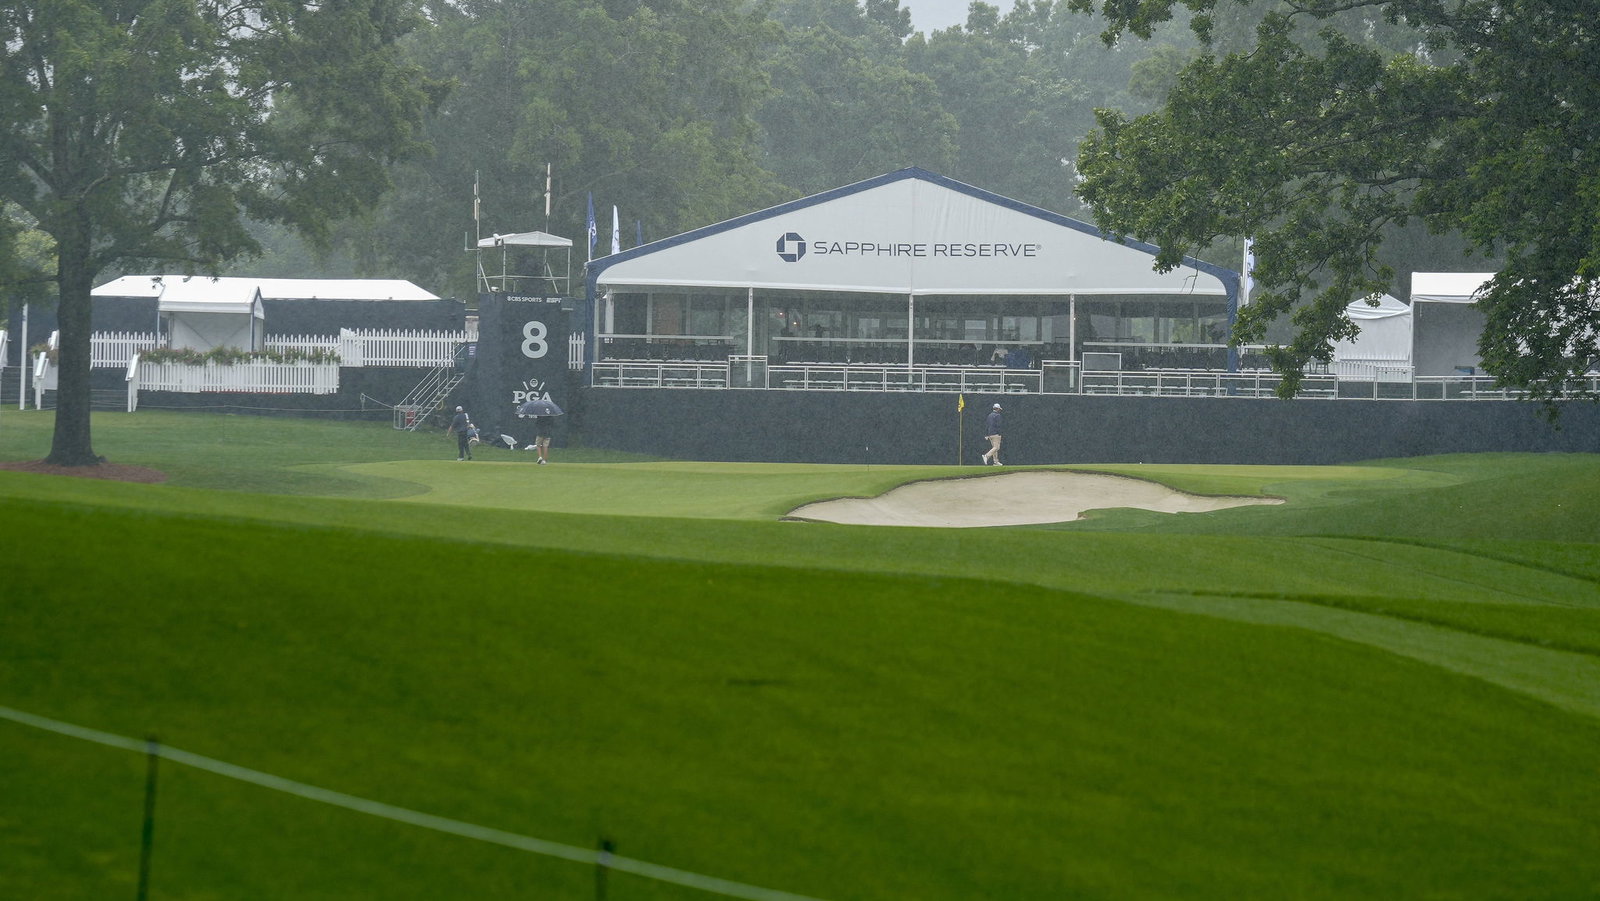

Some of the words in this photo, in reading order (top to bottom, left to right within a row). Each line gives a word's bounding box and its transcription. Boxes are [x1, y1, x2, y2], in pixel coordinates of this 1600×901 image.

[813, 241, 927, 257] SAPPHIRE
[521, 320, 548, 359] 8
[512, 390, 552, 404] PGA
